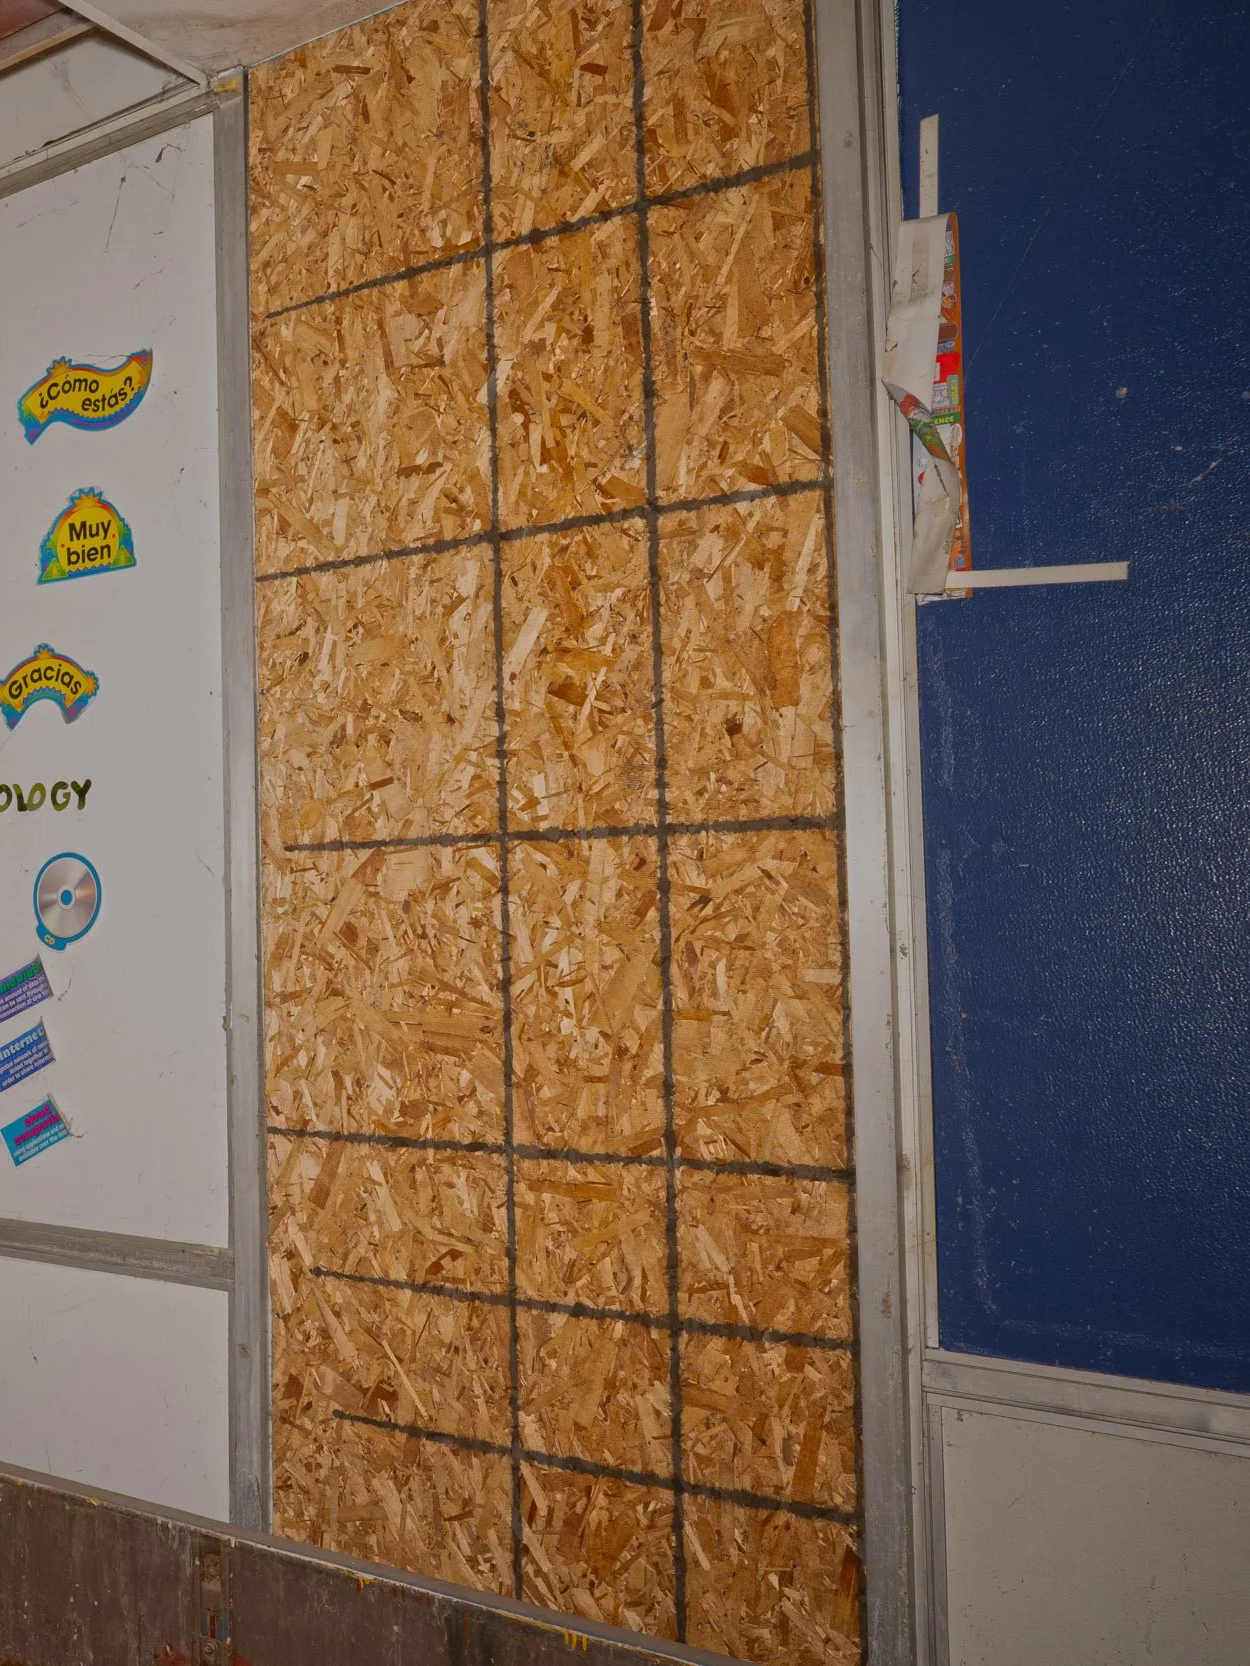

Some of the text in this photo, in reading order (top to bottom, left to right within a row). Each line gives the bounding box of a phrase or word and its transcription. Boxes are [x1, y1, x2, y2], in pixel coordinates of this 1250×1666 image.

[39, 374, 99, 409] ¿Cómo
[81, 376, 134, 412] estás?
[68, 519, 112, 542] Muy
[66, 544, 111, 566] bien
[8, 663, 82, 700] Gracias
